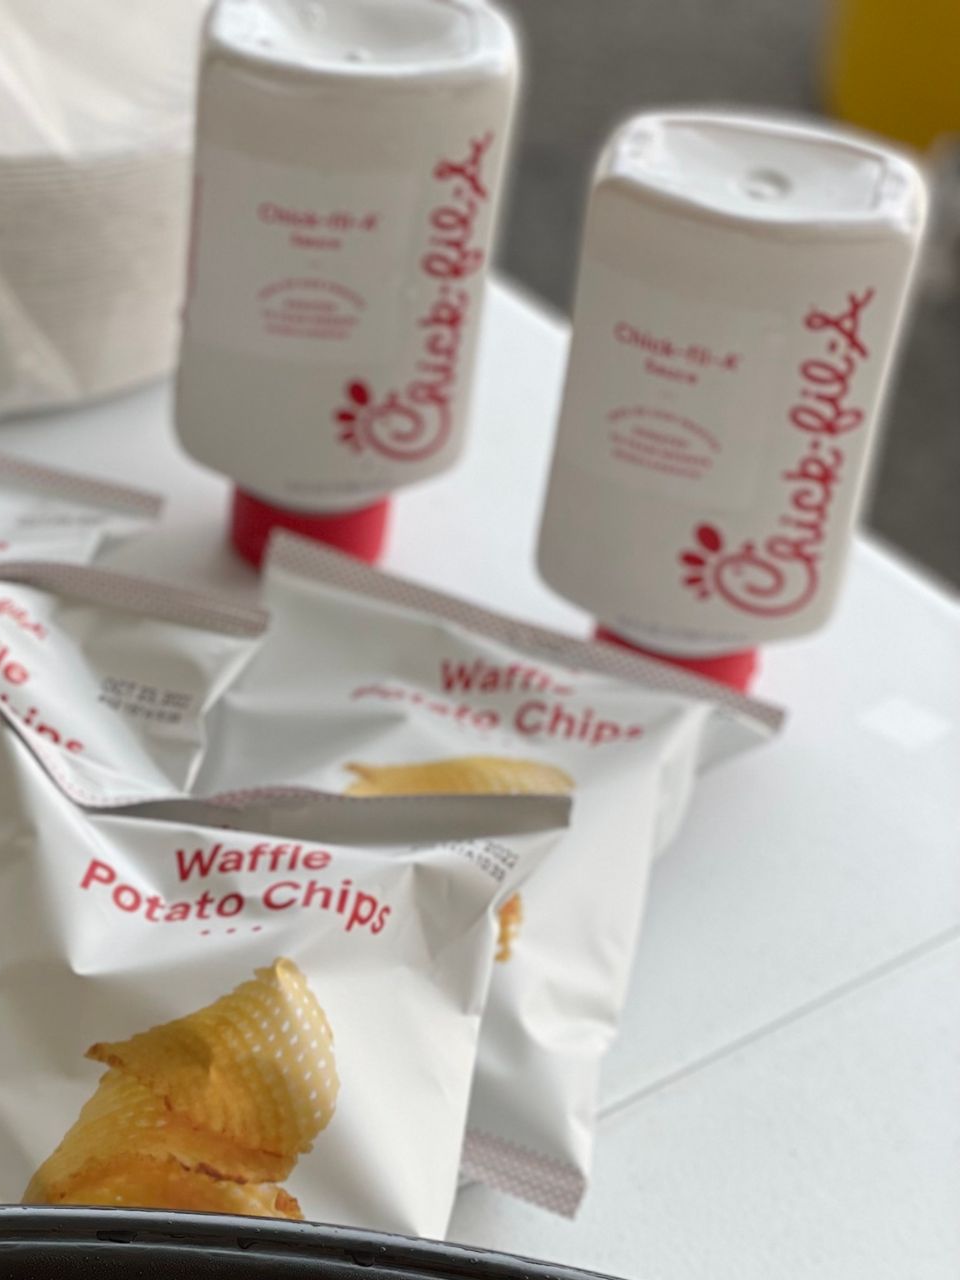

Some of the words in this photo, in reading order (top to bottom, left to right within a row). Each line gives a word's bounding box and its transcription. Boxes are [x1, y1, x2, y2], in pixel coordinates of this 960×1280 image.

[714, 288, 874, 618] Chick-fil-A
[80, 859, 246, 924] Potato
[262, 880, 392, 935] Chips
[176, 843, 332, 882] Waffle
